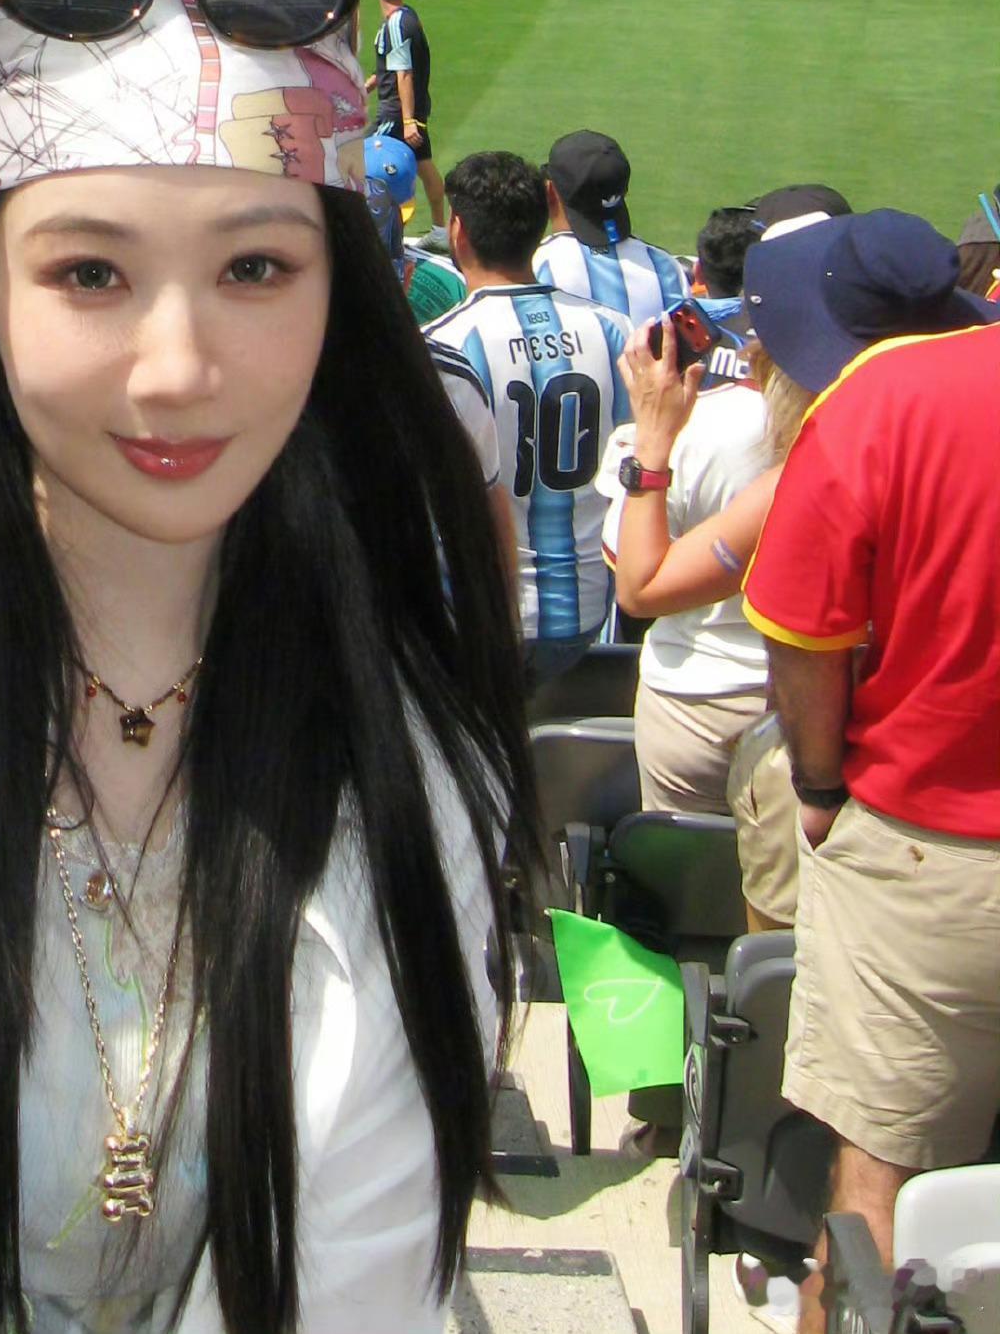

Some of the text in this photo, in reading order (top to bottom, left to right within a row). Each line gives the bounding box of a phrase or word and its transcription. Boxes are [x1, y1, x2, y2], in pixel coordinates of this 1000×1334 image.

[526, 310, 551, 325] 1893
[508, 330, 584, 365] MESSI
[505, 371, 601, 498] 10
